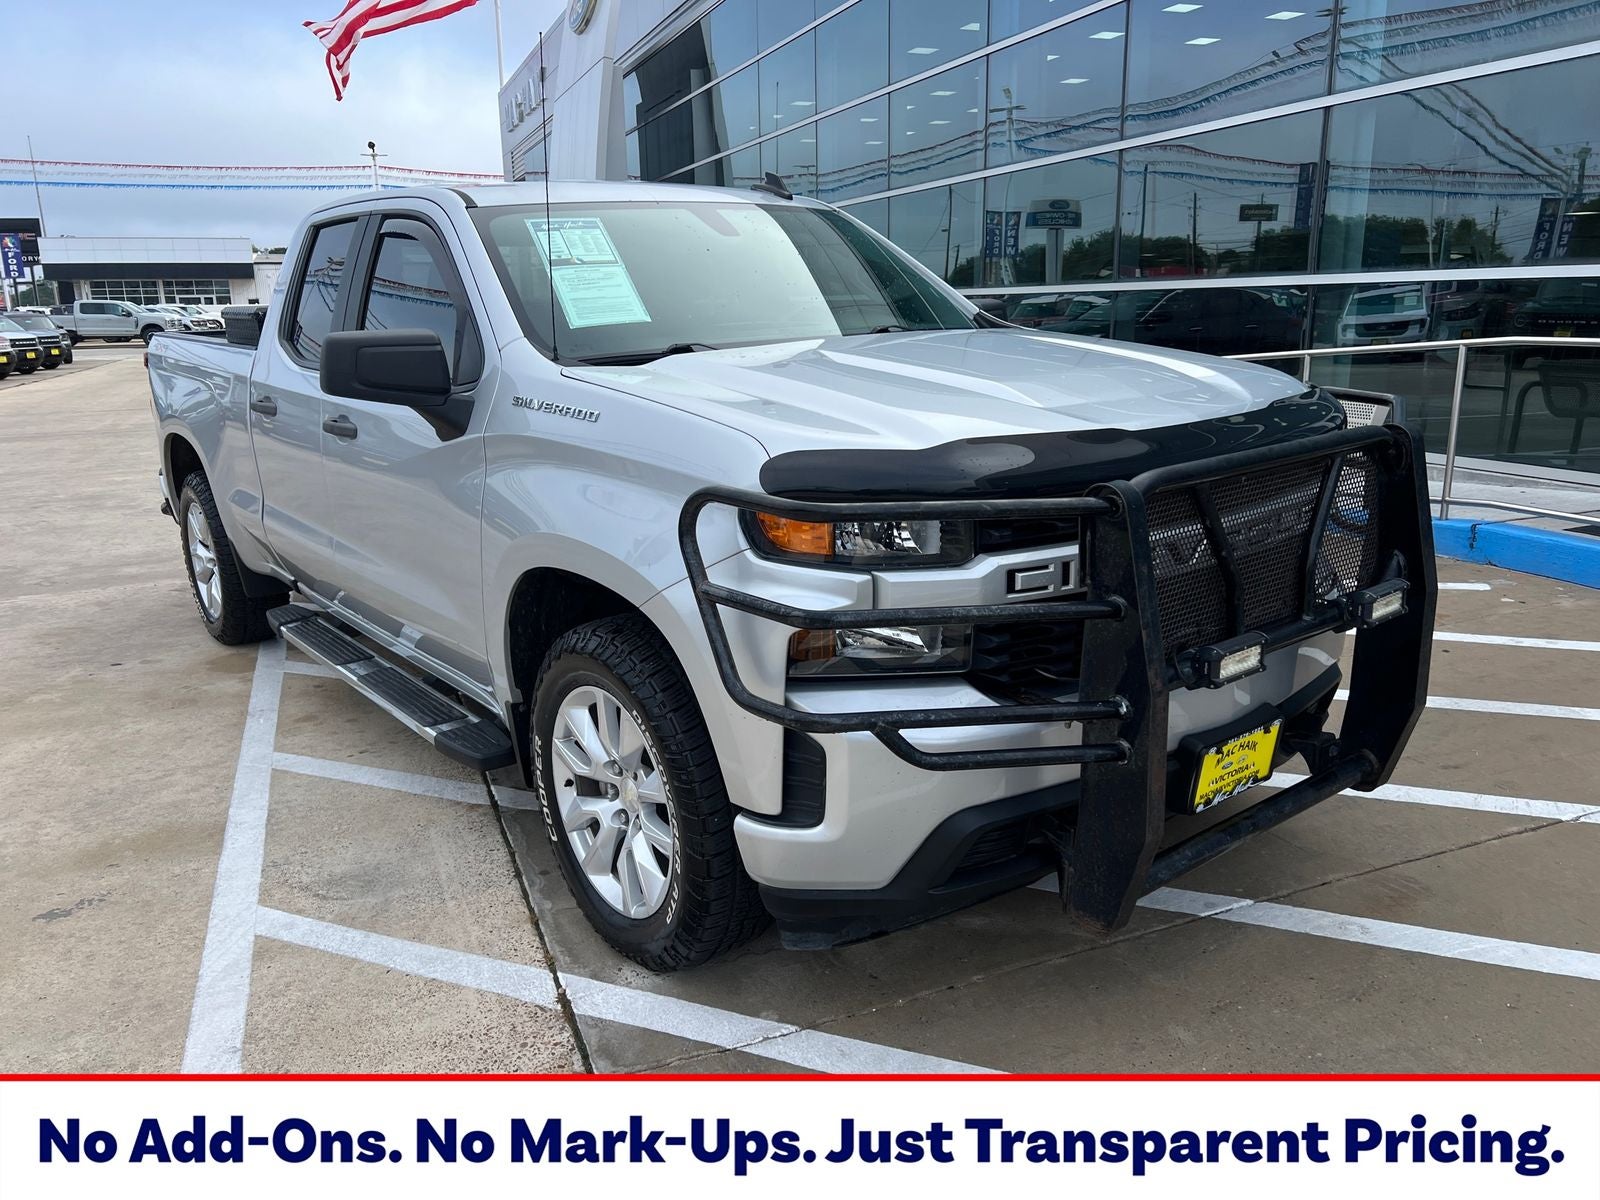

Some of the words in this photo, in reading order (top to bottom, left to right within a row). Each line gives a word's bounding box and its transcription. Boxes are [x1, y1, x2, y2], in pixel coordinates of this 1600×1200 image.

[8, 251, 19, 278] FORD
[511, 394, 601, 423] SILVERADO
[1215, 744, 1238, 768] MAC
[1238, 740, 1258, 752] HAIK
[534, 735, 558, 842] COOPER
[632, 709, 682, 875] DISCOVERER
